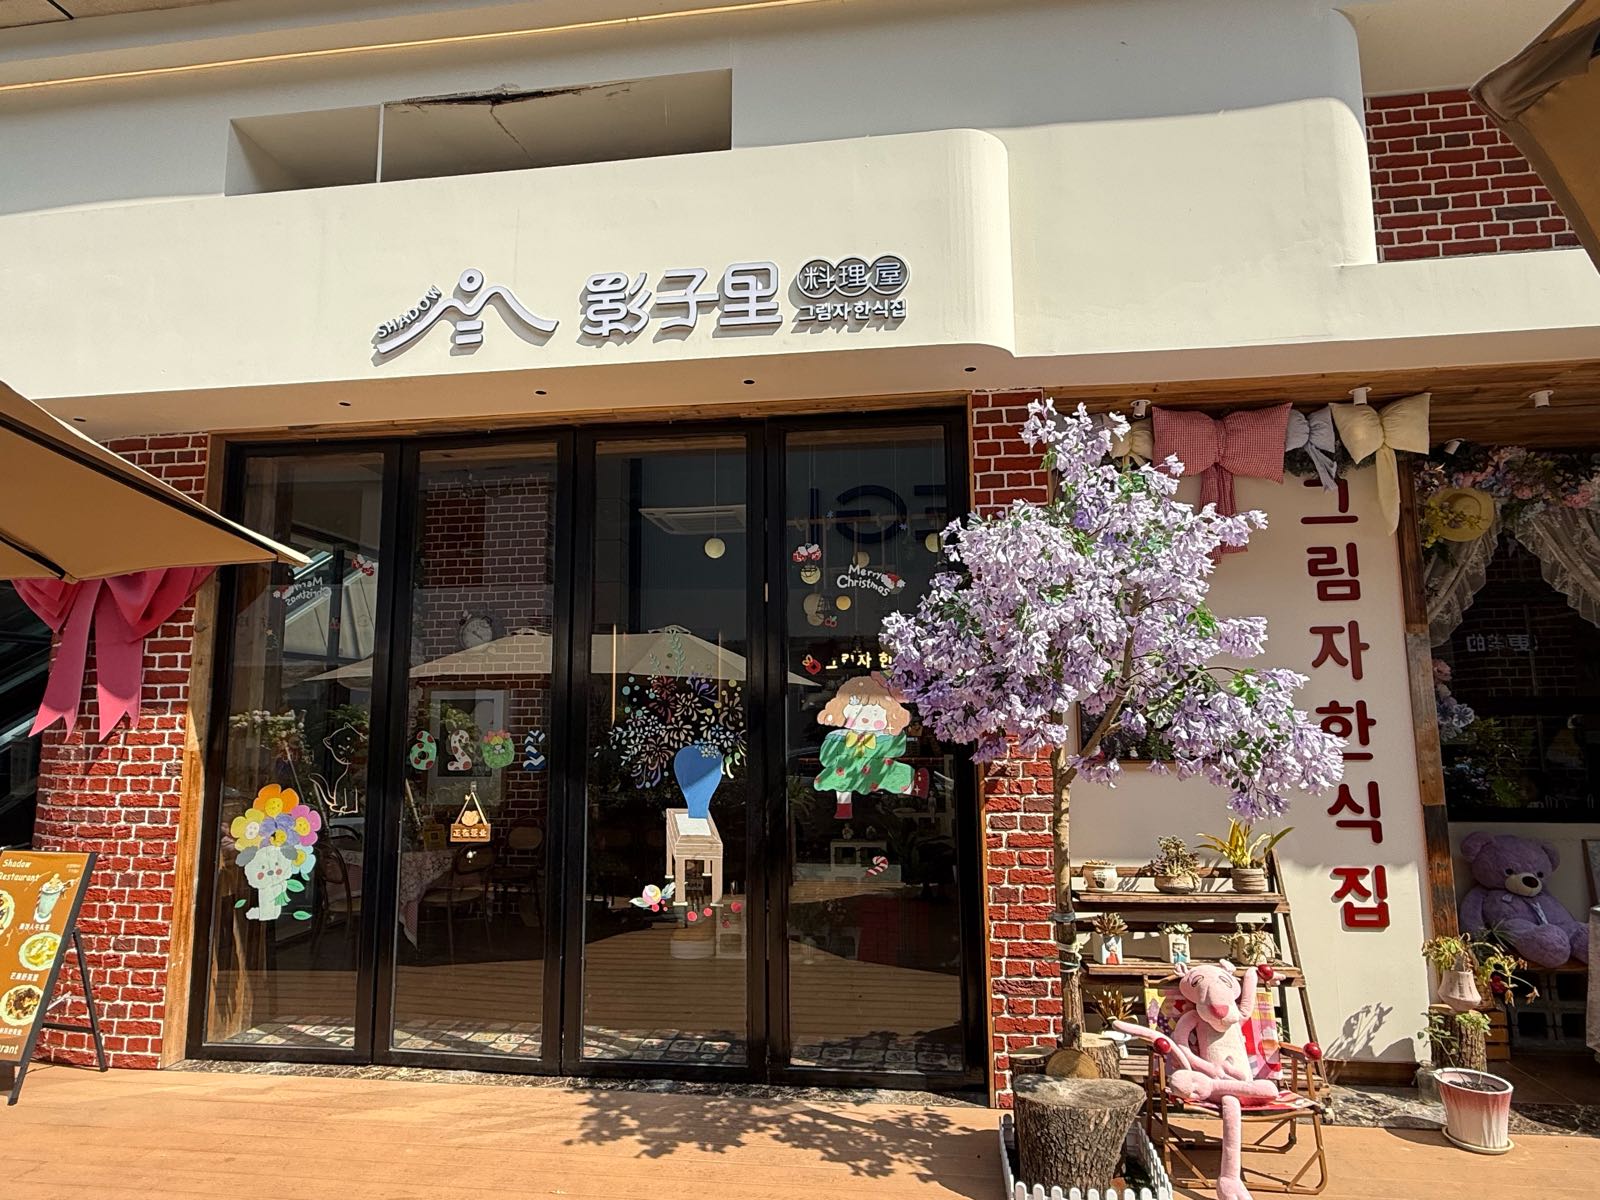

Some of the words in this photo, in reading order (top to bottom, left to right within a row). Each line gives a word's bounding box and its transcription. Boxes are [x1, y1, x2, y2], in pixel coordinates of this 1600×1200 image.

[802, 261, 903, 290] 料理屋
[582, 262, 782, 336] 影子里
[798, 302, 850, 321] 그림자
[853, 299, 907, 320] 한식집
[377, 284, 442, 338] SHADOW
[848, 564, 883, 580] Merry
[836, 574, 891, 596] Christmas
[2, 858, 32, 869] Shadow
[0, 871, 40, 882] Restaurant
[0, 1044, 19, 1055] rant
